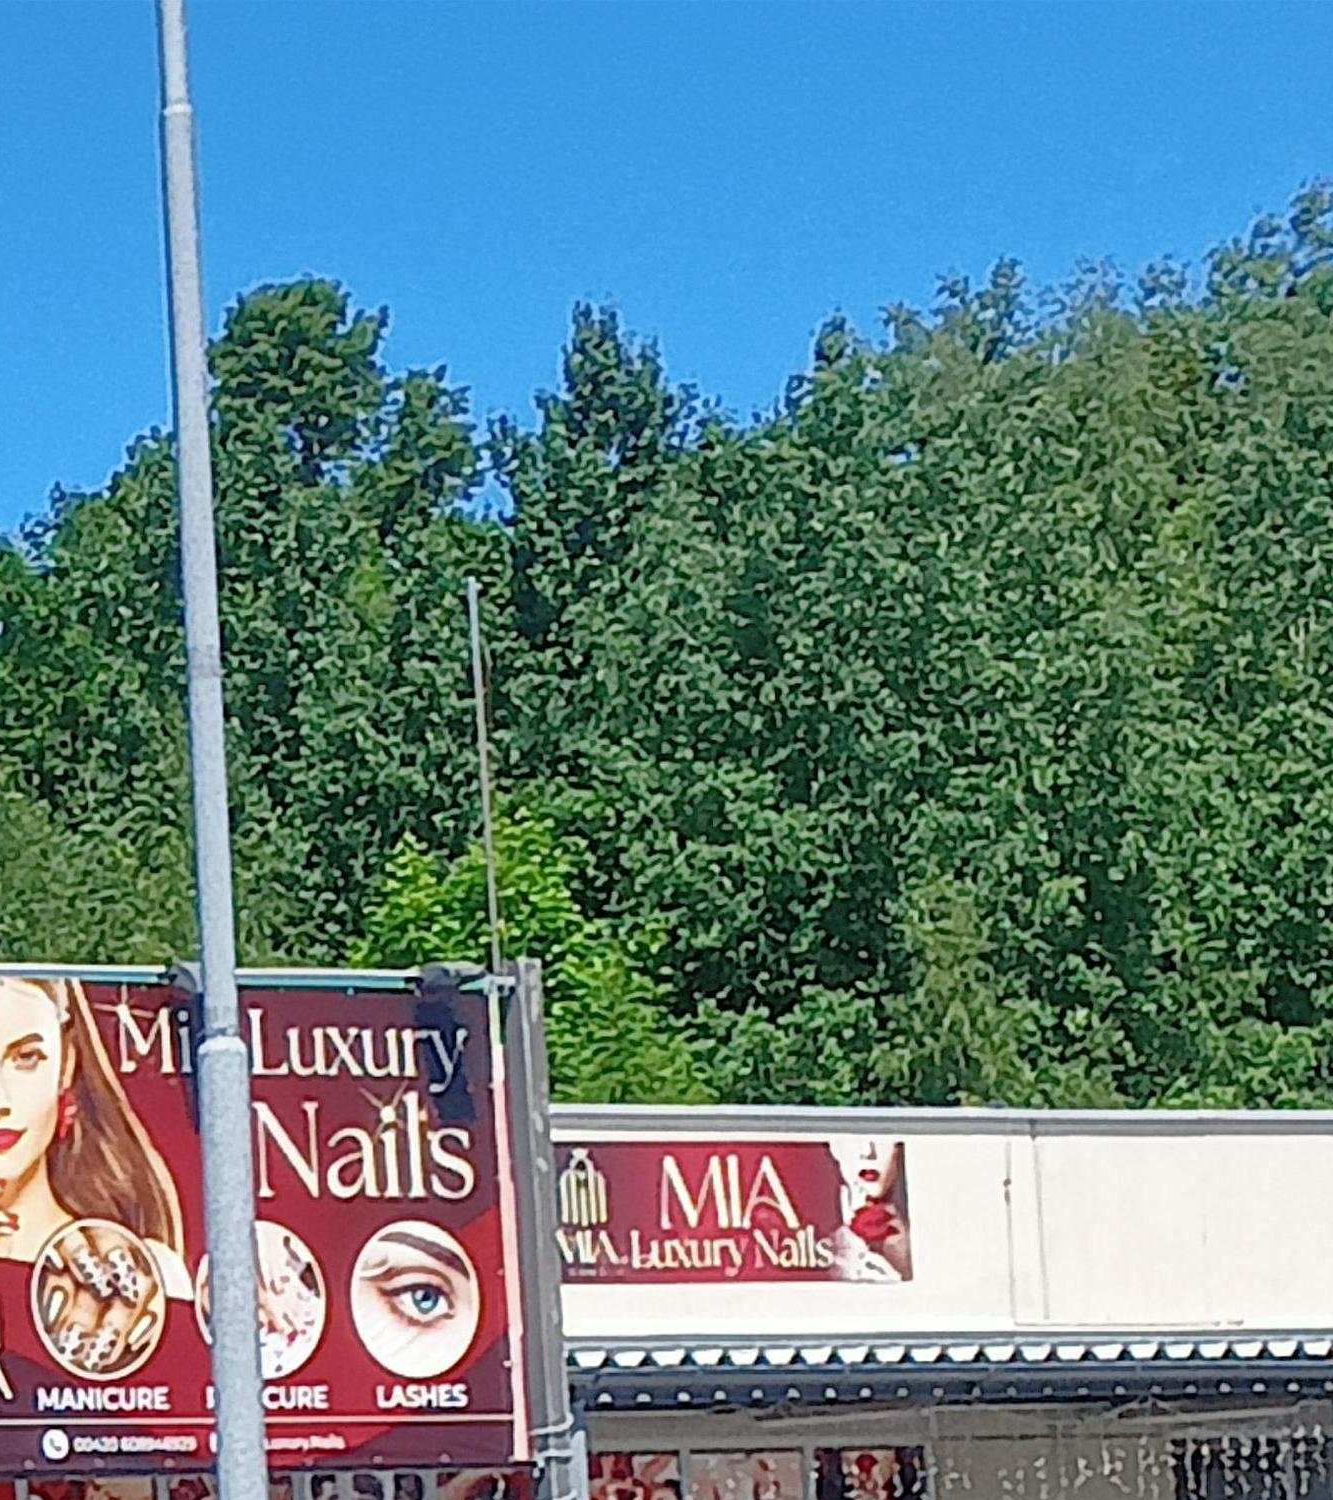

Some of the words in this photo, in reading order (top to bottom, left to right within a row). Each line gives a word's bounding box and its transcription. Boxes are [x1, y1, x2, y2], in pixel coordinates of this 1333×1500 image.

[117, 1003, 193, 1074] Mi
[246, 1007, 469, 1093] Luxury
[252, 1090, 475, 1199] Nails
[660, 1153, 800, 1230] MIA
[630, 1229, 749, 1277] Luxury
[753, 1225, 834, 1268] Nails
[36, 1386, 171, 1411] MANICURE
[375, 1383, 469, 1409] LASHES
